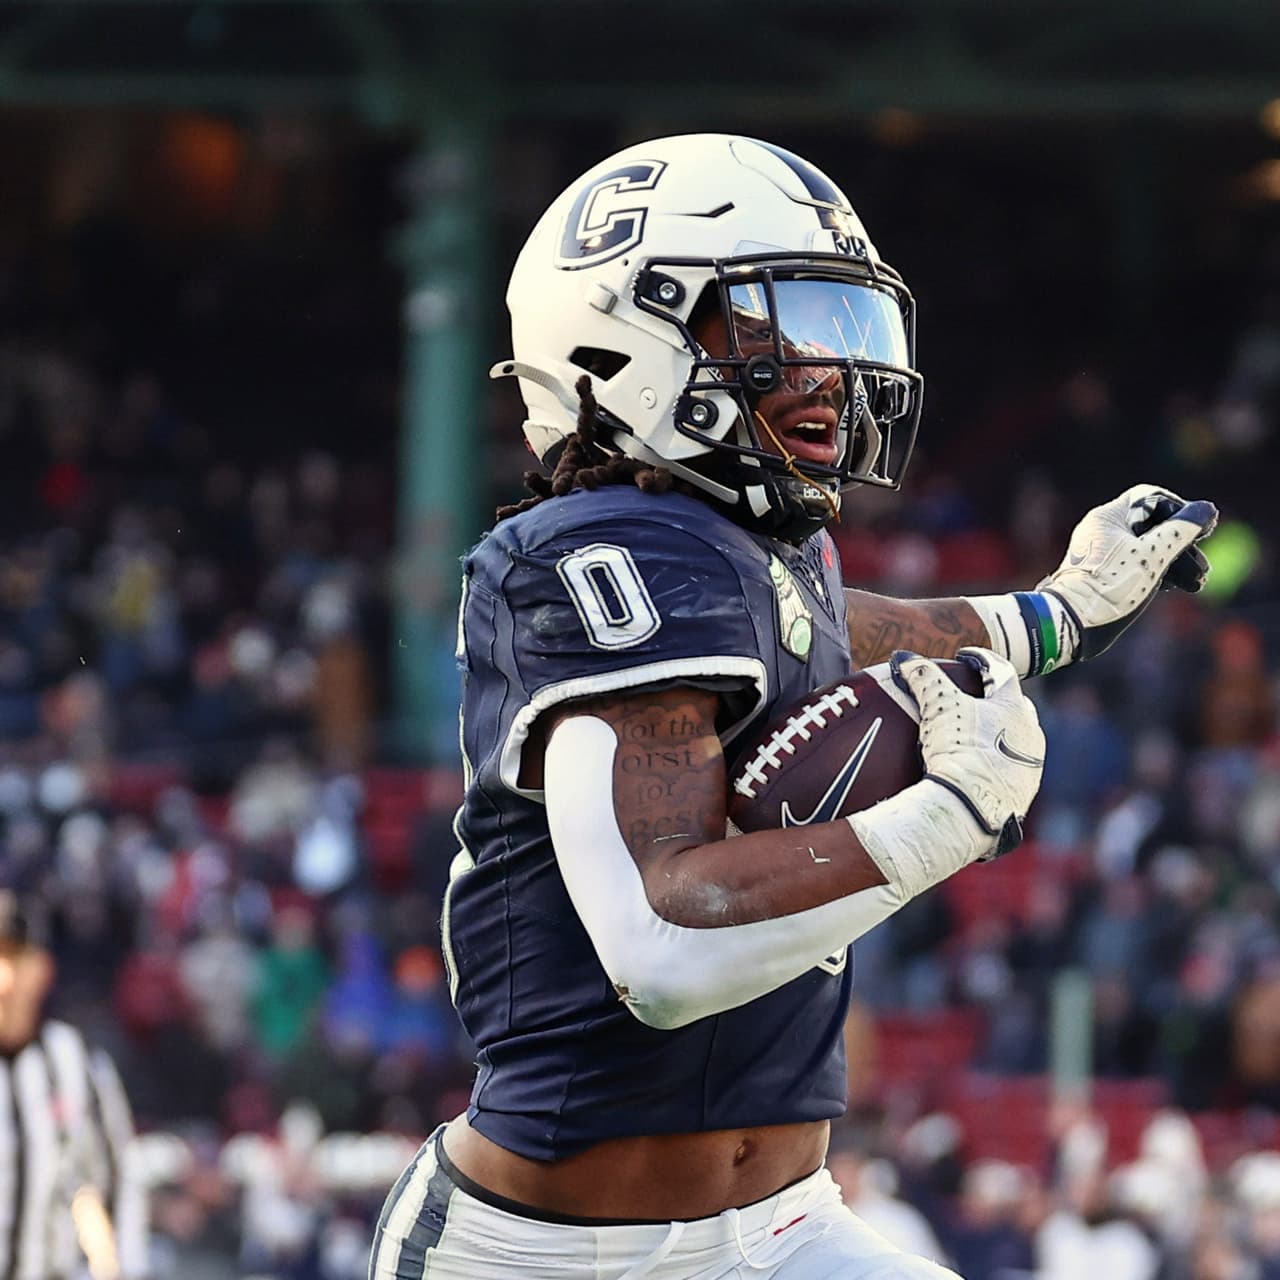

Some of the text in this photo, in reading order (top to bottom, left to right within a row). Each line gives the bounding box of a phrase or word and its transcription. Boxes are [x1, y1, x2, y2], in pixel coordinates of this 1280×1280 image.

[554, 159, 669, 271] C
[555, 543, 662, 651] 0
[621, 748, 695, 774] orst
